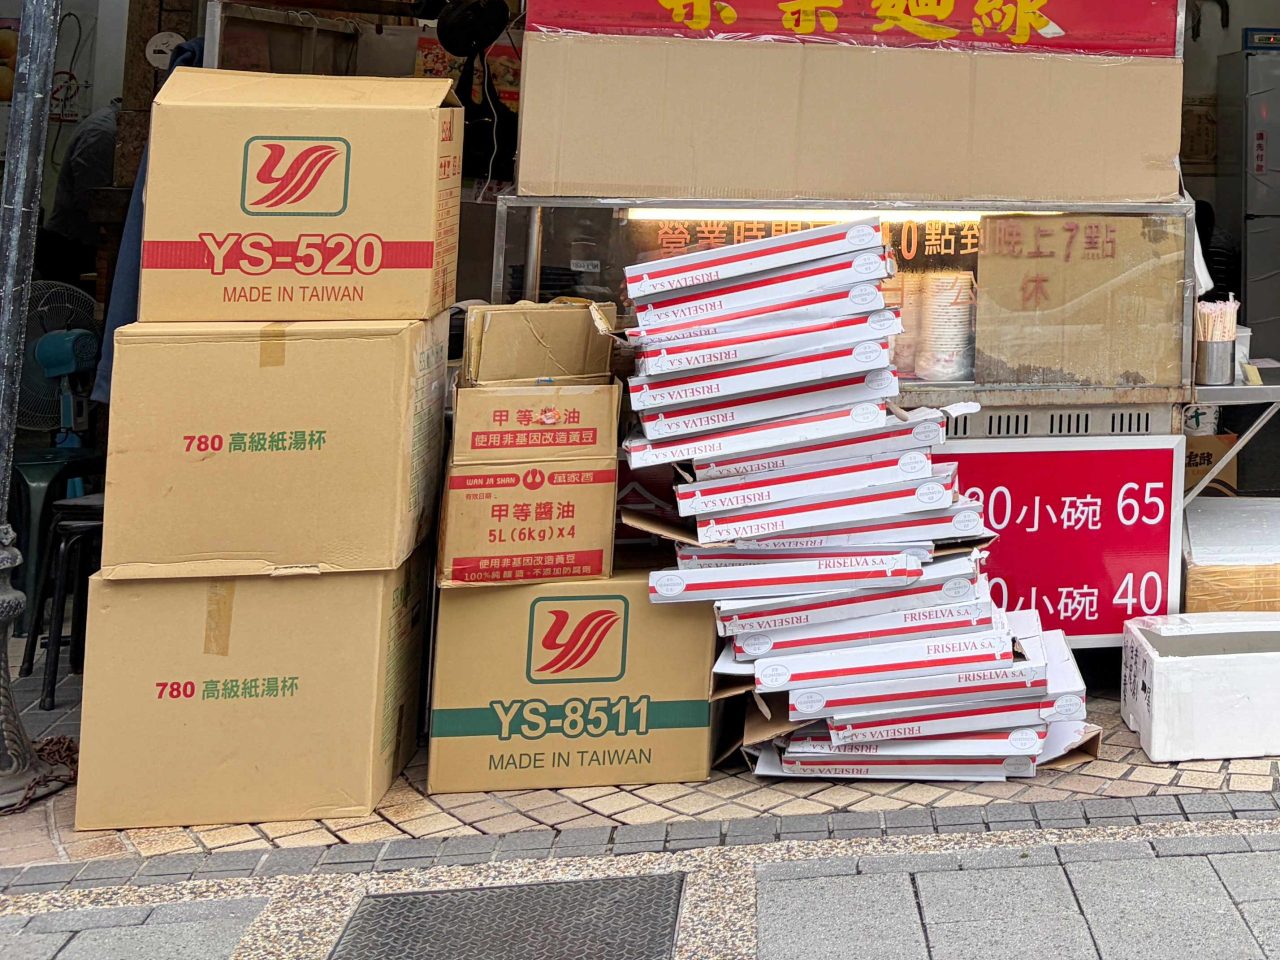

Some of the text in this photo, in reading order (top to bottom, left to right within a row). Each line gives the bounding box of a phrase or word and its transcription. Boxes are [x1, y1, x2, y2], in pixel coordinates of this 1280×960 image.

[199, 233, 383, 275] YS-520
[668, 271, 720, 289] FRISELVA
[223, 286, 364, 302] MADE IN TAIWAN
[672, 301, 723, 318] FRISELVA
[686, 350, 737, 366] FRISELVA
[668, 384, 721, 401] FRISELVA
[683, 412, 736, 429] FRISELVA
[183, 430, 327, 452] 780 高級紙湯杯
[475, 430, 594, 447] 使用非基因改造黃豆
[671, 443, 722, 459] FRISELVA
[466, 478, 483, 486] WAN
[496, 477, 516, 485] SHAN
[720, 491, 771, 507] FRISELVA
[1117, 482, 1165, 526] 65
[491, 501, 576, 523] 甲等醬油
[734, 520, 785, 537] FRISELVA
[818, 557, 869, 569] FRISELVA
[1112, 571, 1162, 615] 40
[757, 615, 809, 629] FRISELVA
[903, 609, 954, 622] FRISELVA
[927, 641, 978, 655] FRISELVA
[958, 670, 1008, 683] FRISELVA
[155, 676, 299, 700] 780 高級紙湯杯
[489, 695, 651, 740] YS-8511
[870, 726, 921, 739] FRISELVA
[488, 748, 651, 771] MADE IN TAIWAN
